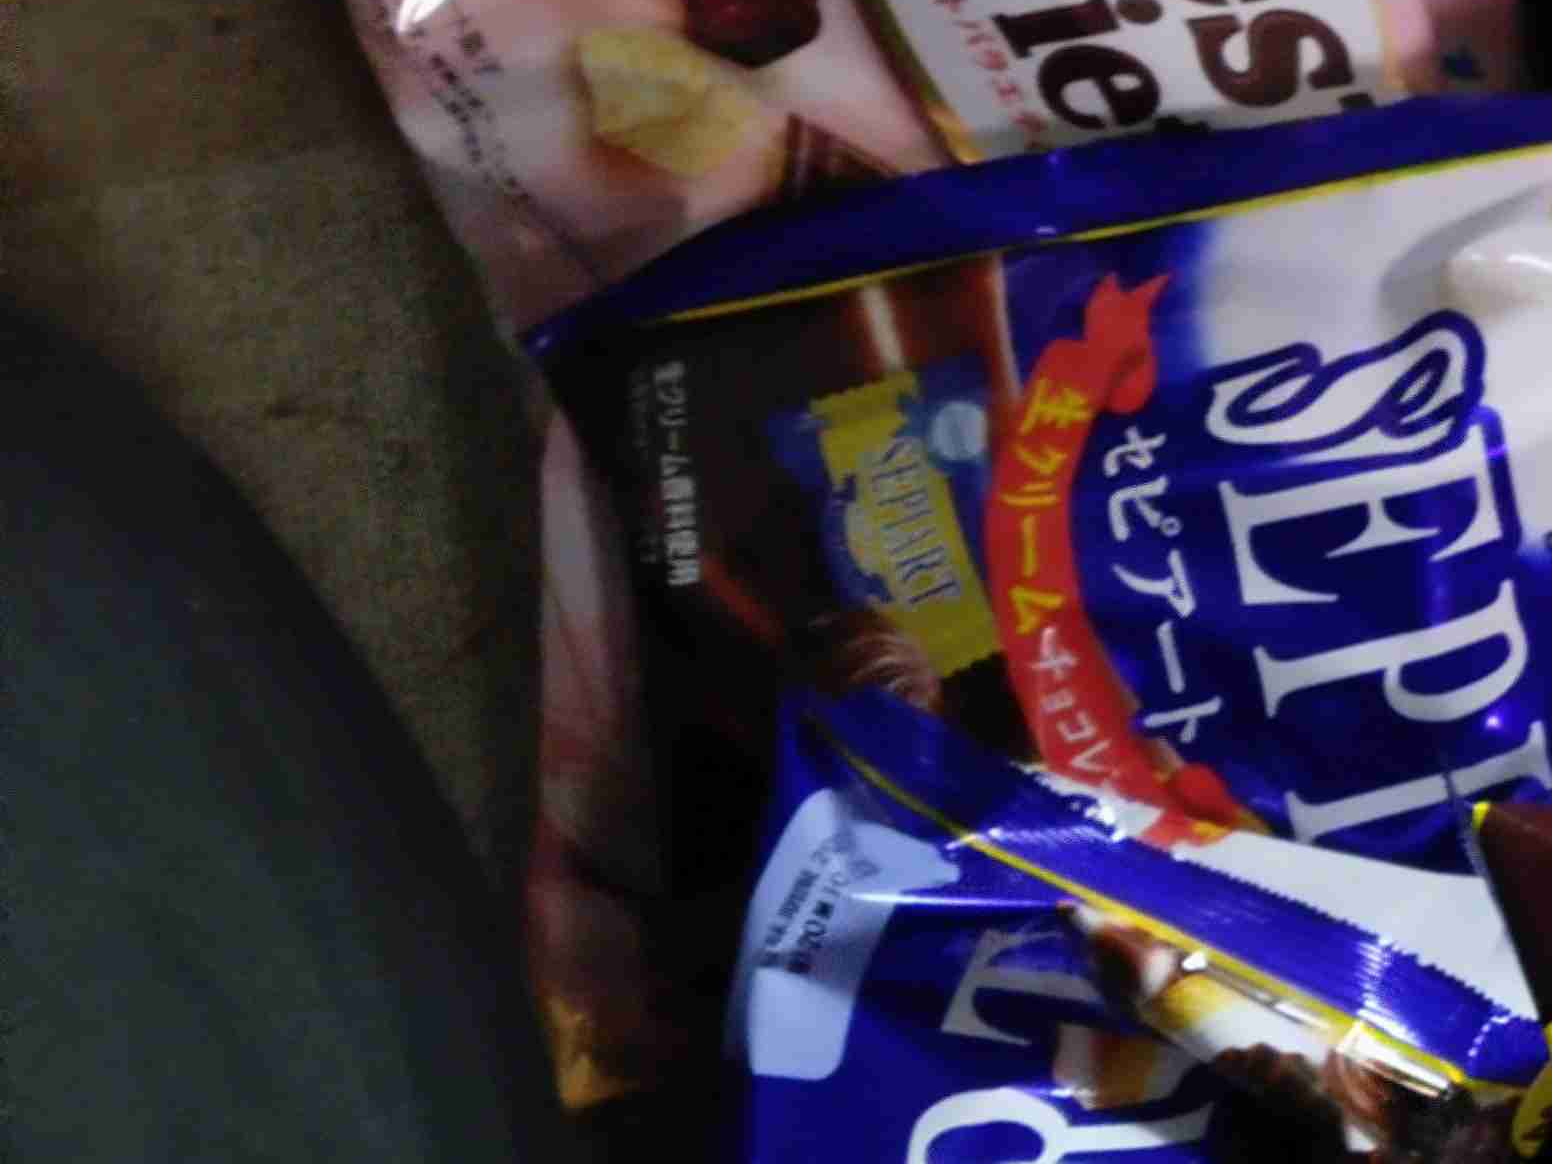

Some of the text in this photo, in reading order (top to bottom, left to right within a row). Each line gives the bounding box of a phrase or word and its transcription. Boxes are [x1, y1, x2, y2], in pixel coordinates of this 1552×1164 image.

[1102, 424, 1224, 743] セピアート
